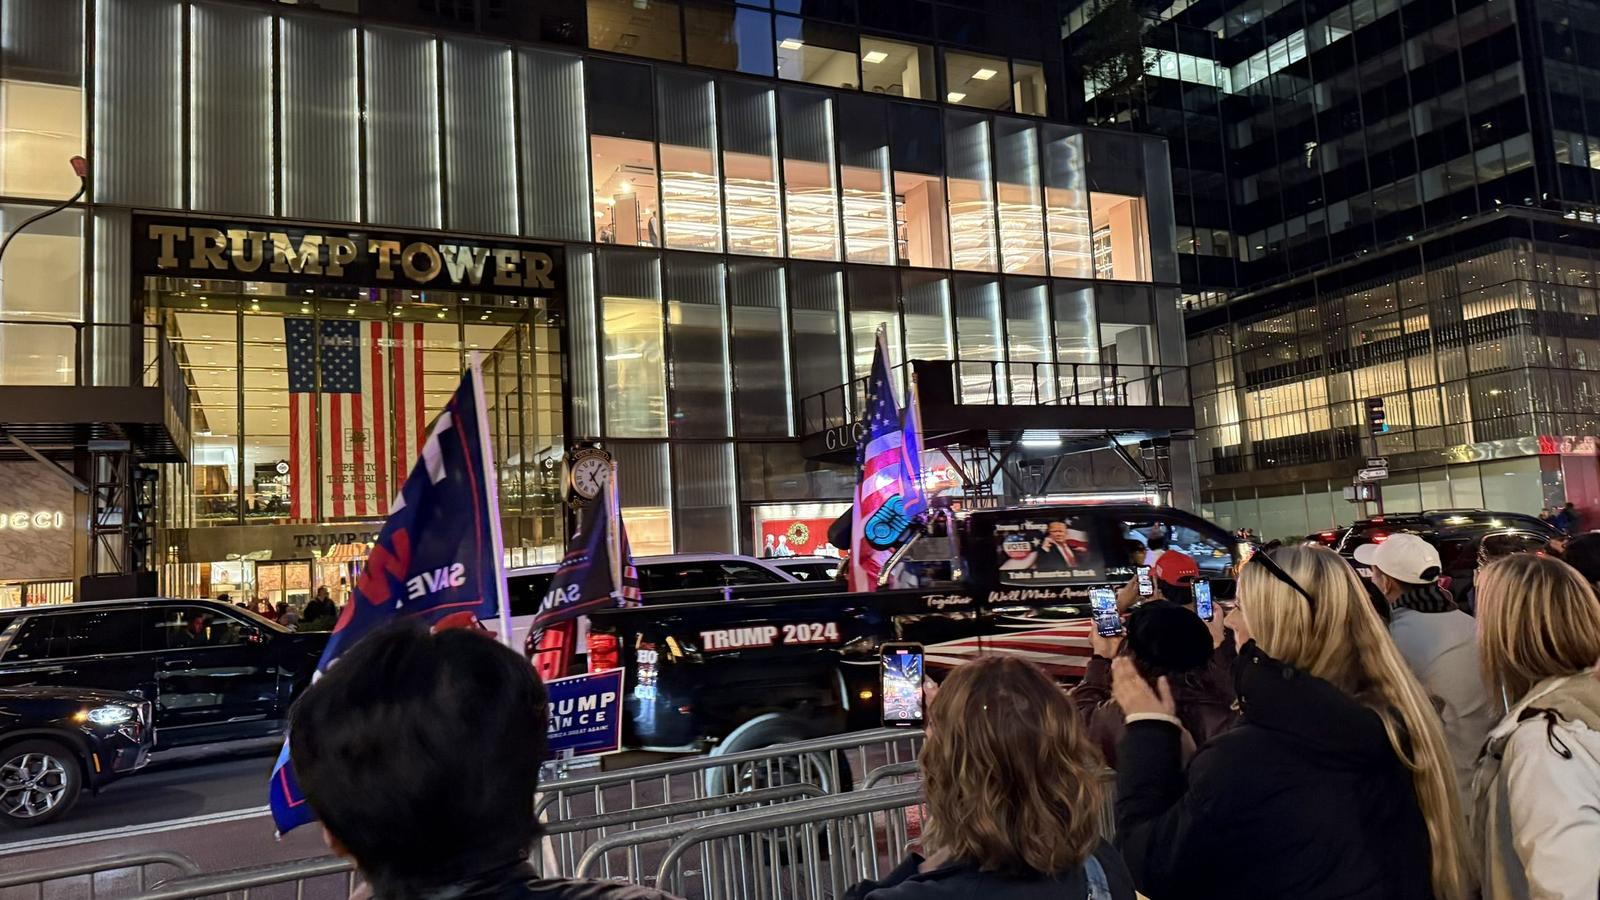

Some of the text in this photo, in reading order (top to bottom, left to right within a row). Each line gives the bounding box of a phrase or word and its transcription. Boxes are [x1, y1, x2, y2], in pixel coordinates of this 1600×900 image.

[149, 225, 555, 289] TRUMP TOWER
[294, 533, 356, 547] TRUMP
[700, 622, 839, 650] TRUMP 2024
